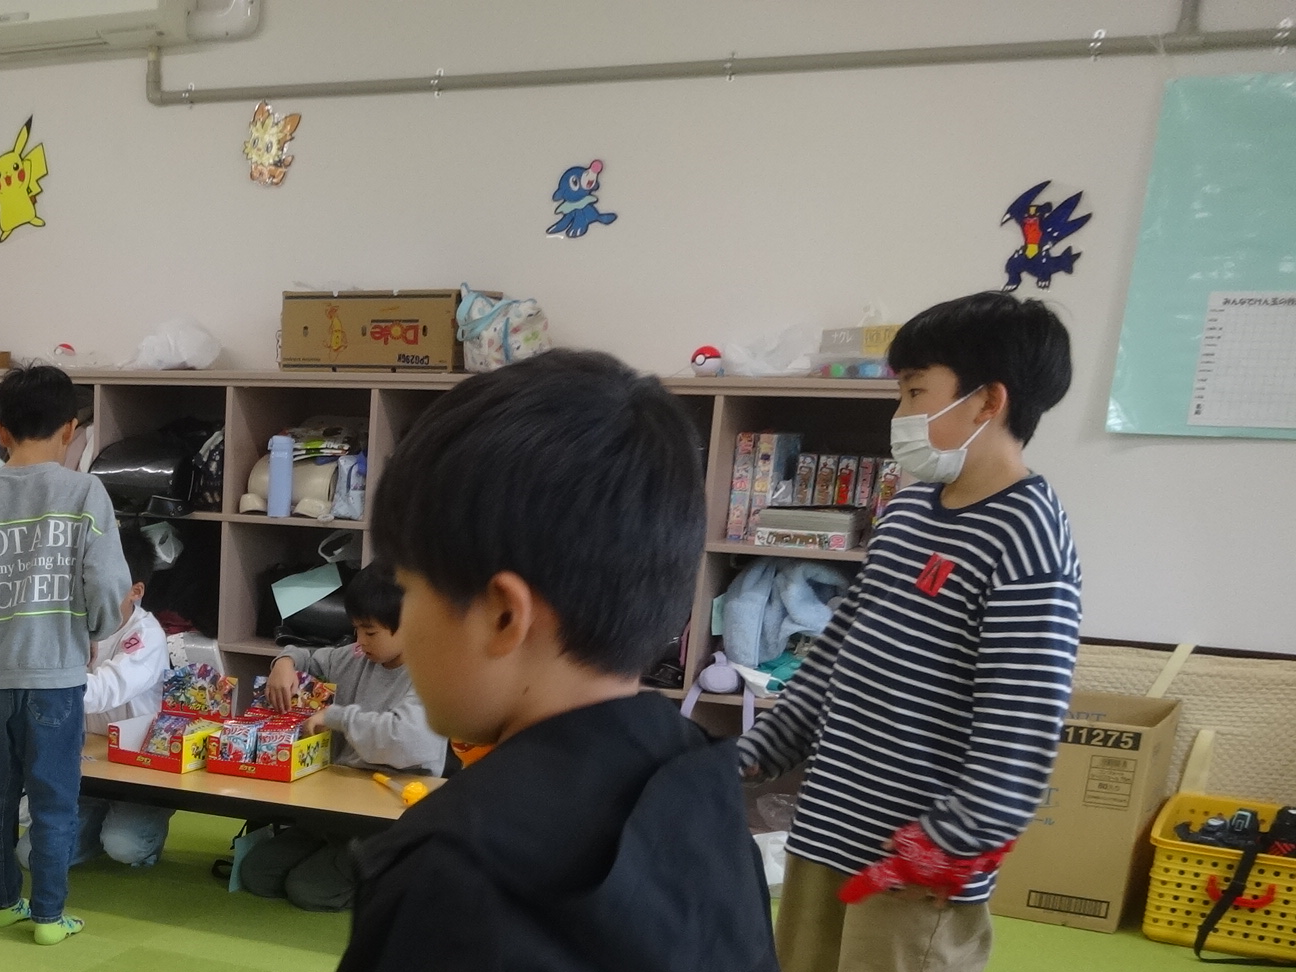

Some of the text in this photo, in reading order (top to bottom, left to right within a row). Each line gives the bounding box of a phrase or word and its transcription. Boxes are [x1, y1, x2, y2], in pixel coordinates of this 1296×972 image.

[370, 321, 419, 346] Dole
[124, 637, 140, 650] B
[1065, 726, 1134, 749] 11275
